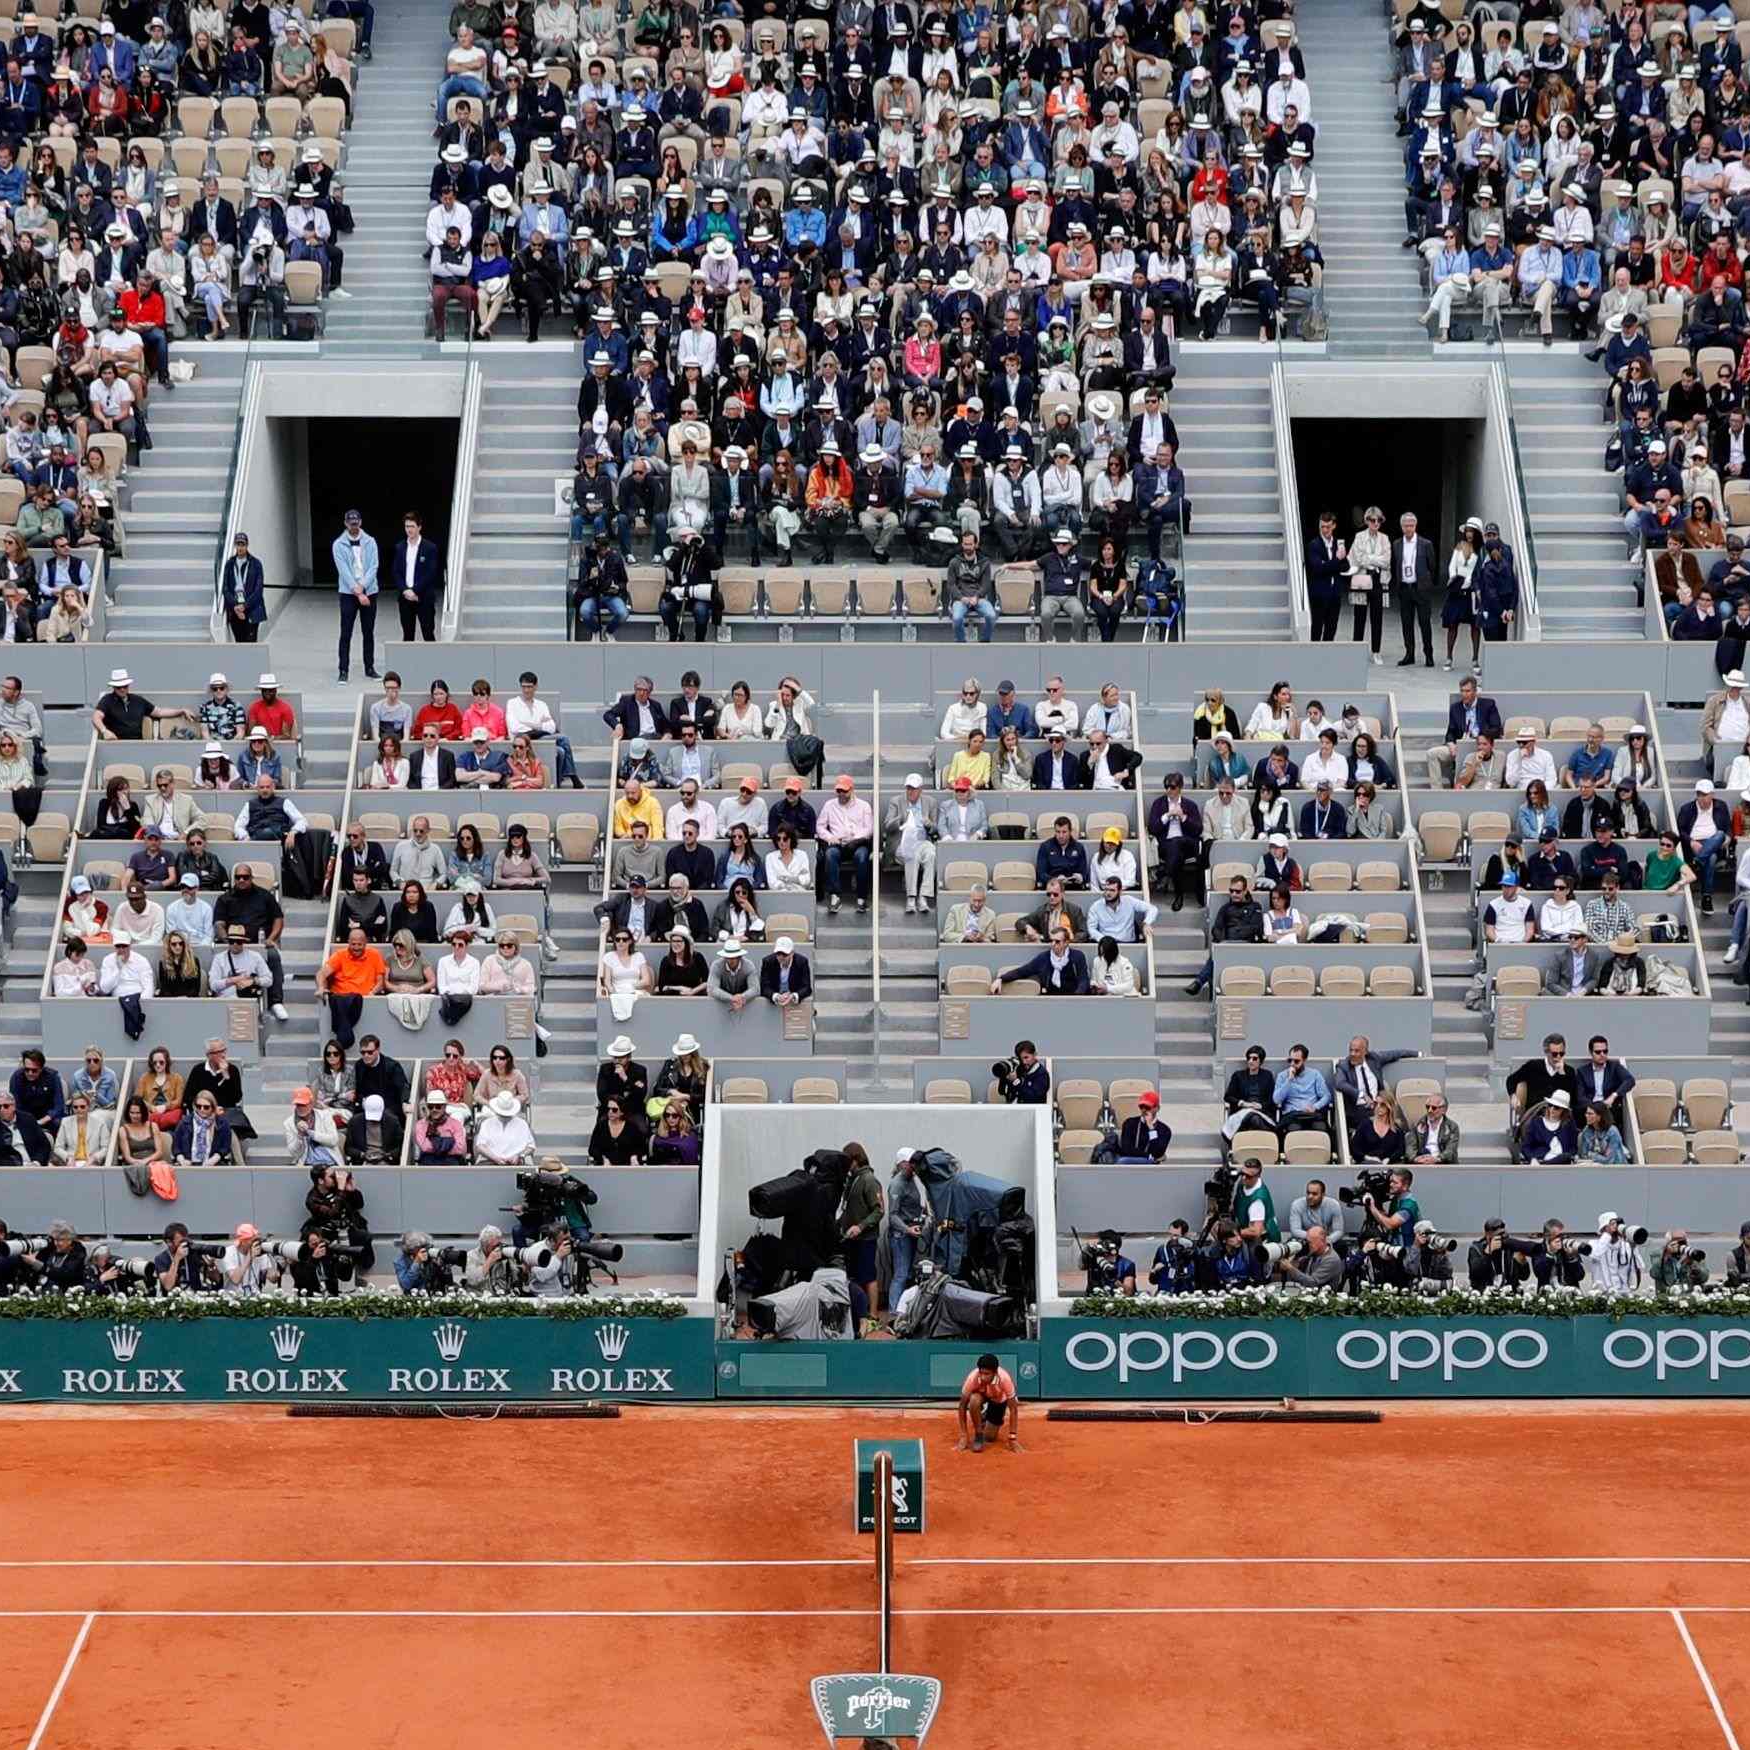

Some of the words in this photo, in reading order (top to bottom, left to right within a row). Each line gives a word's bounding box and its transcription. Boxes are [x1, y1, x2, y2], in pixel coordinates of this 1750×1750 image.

[63, 1369, 187, 1393] ROLEX
[226, 1369, 349, 1393] ROLEX
[389, 1368, 512, 1393] ROLEX
[551, 1368, 675, 1393] ROLEX
